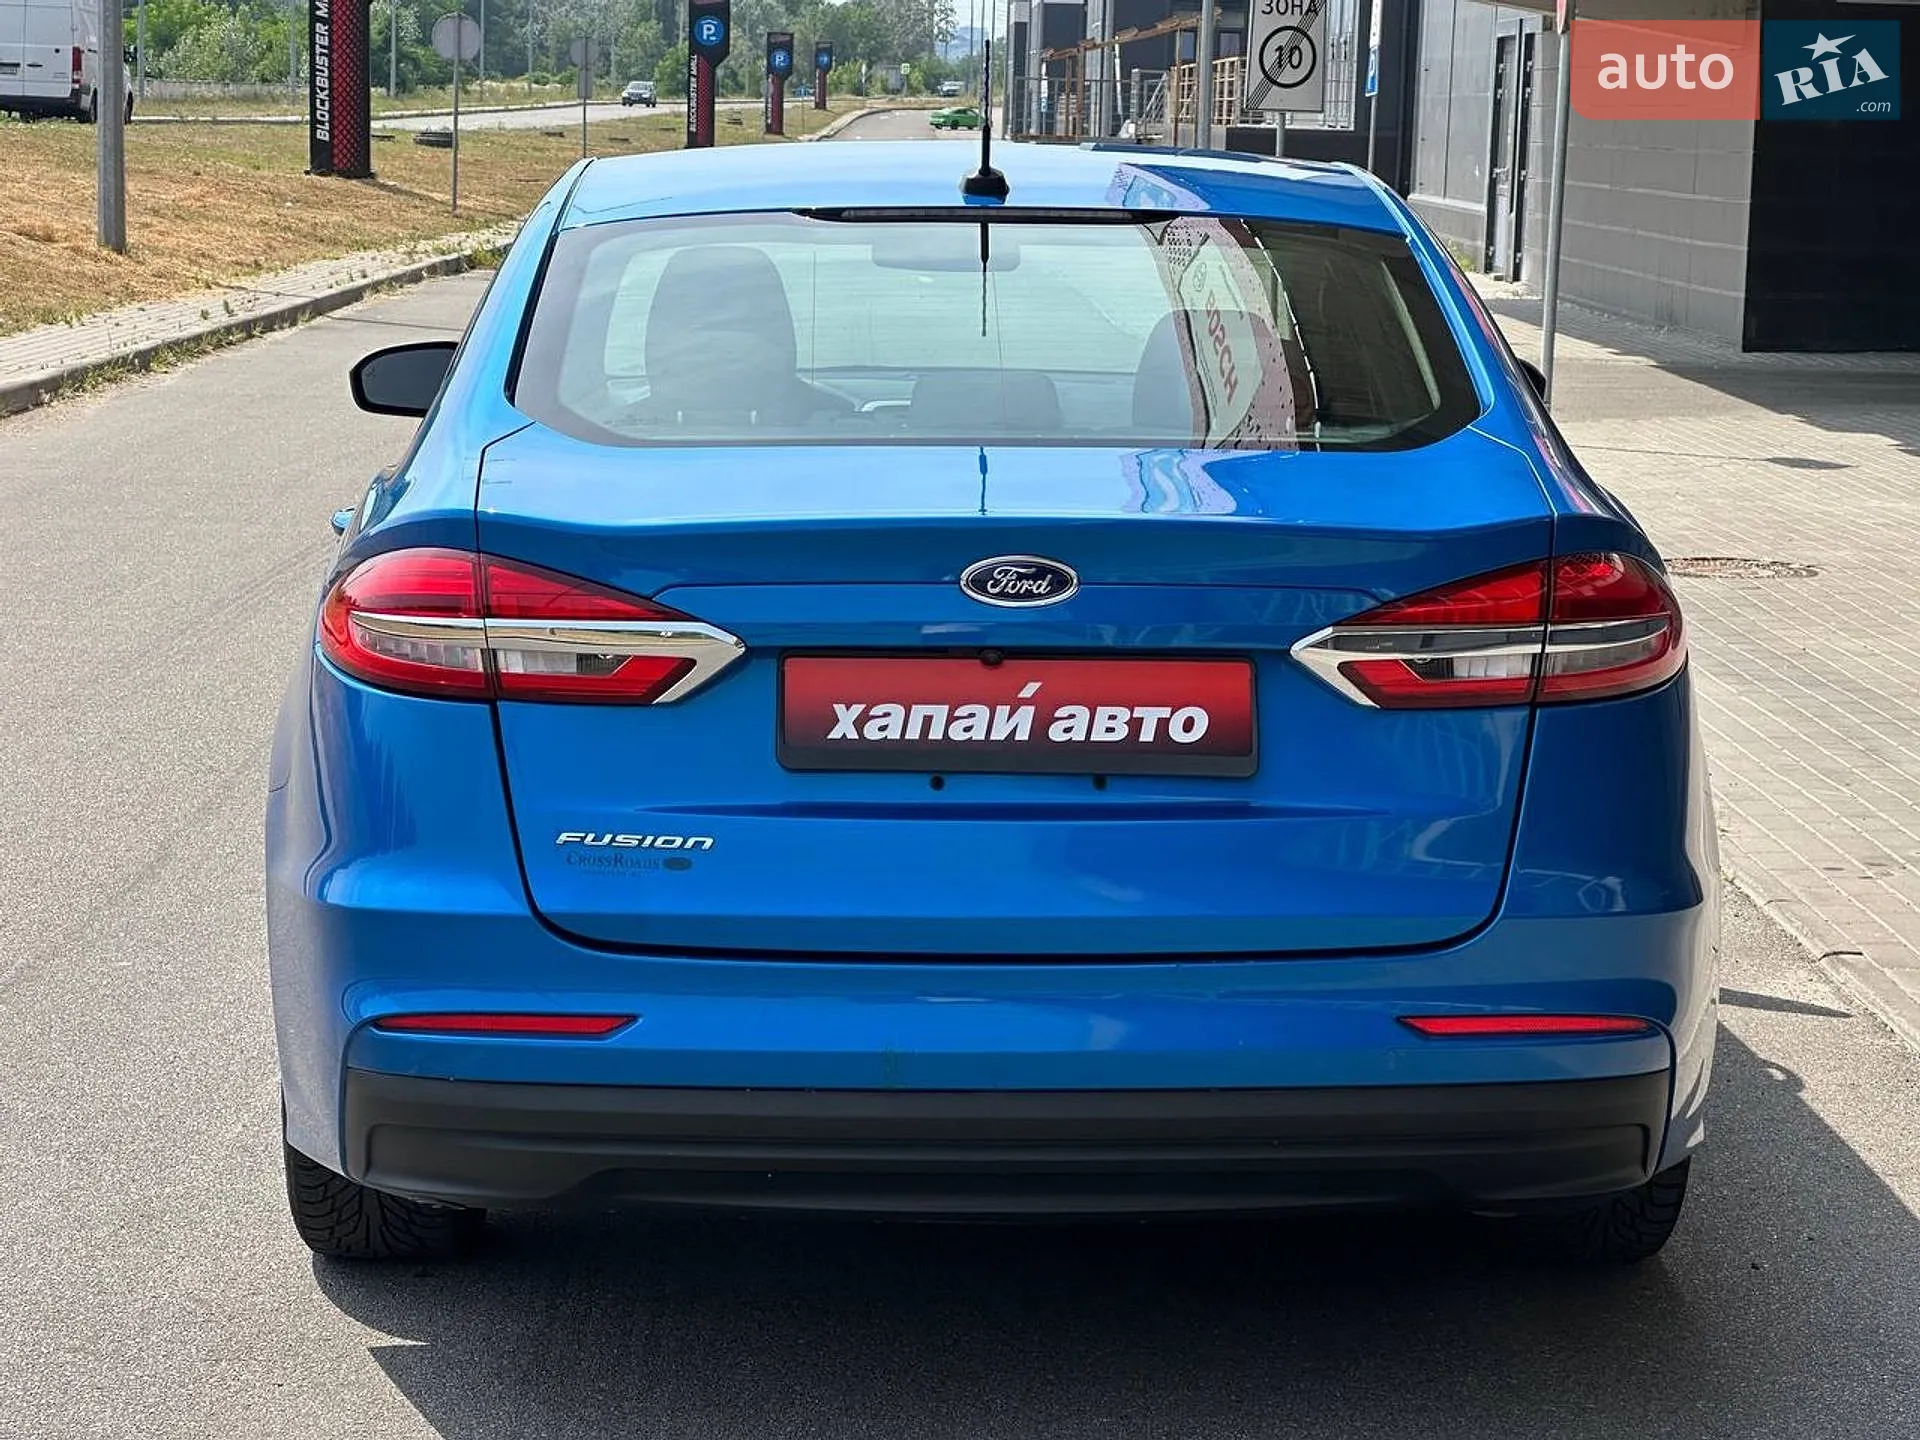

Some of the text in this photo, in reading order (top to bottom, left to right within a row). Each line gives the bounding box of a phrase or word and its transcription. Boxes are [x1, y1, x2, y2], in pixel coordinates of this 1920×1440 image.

[315, 0, 330, 142] BLOCKBUSTER M
[986, 565, 1053, 594] Ford
[826, 681, 1210, 744] хапай авто
[555, 832, 714, 850] FUSION
